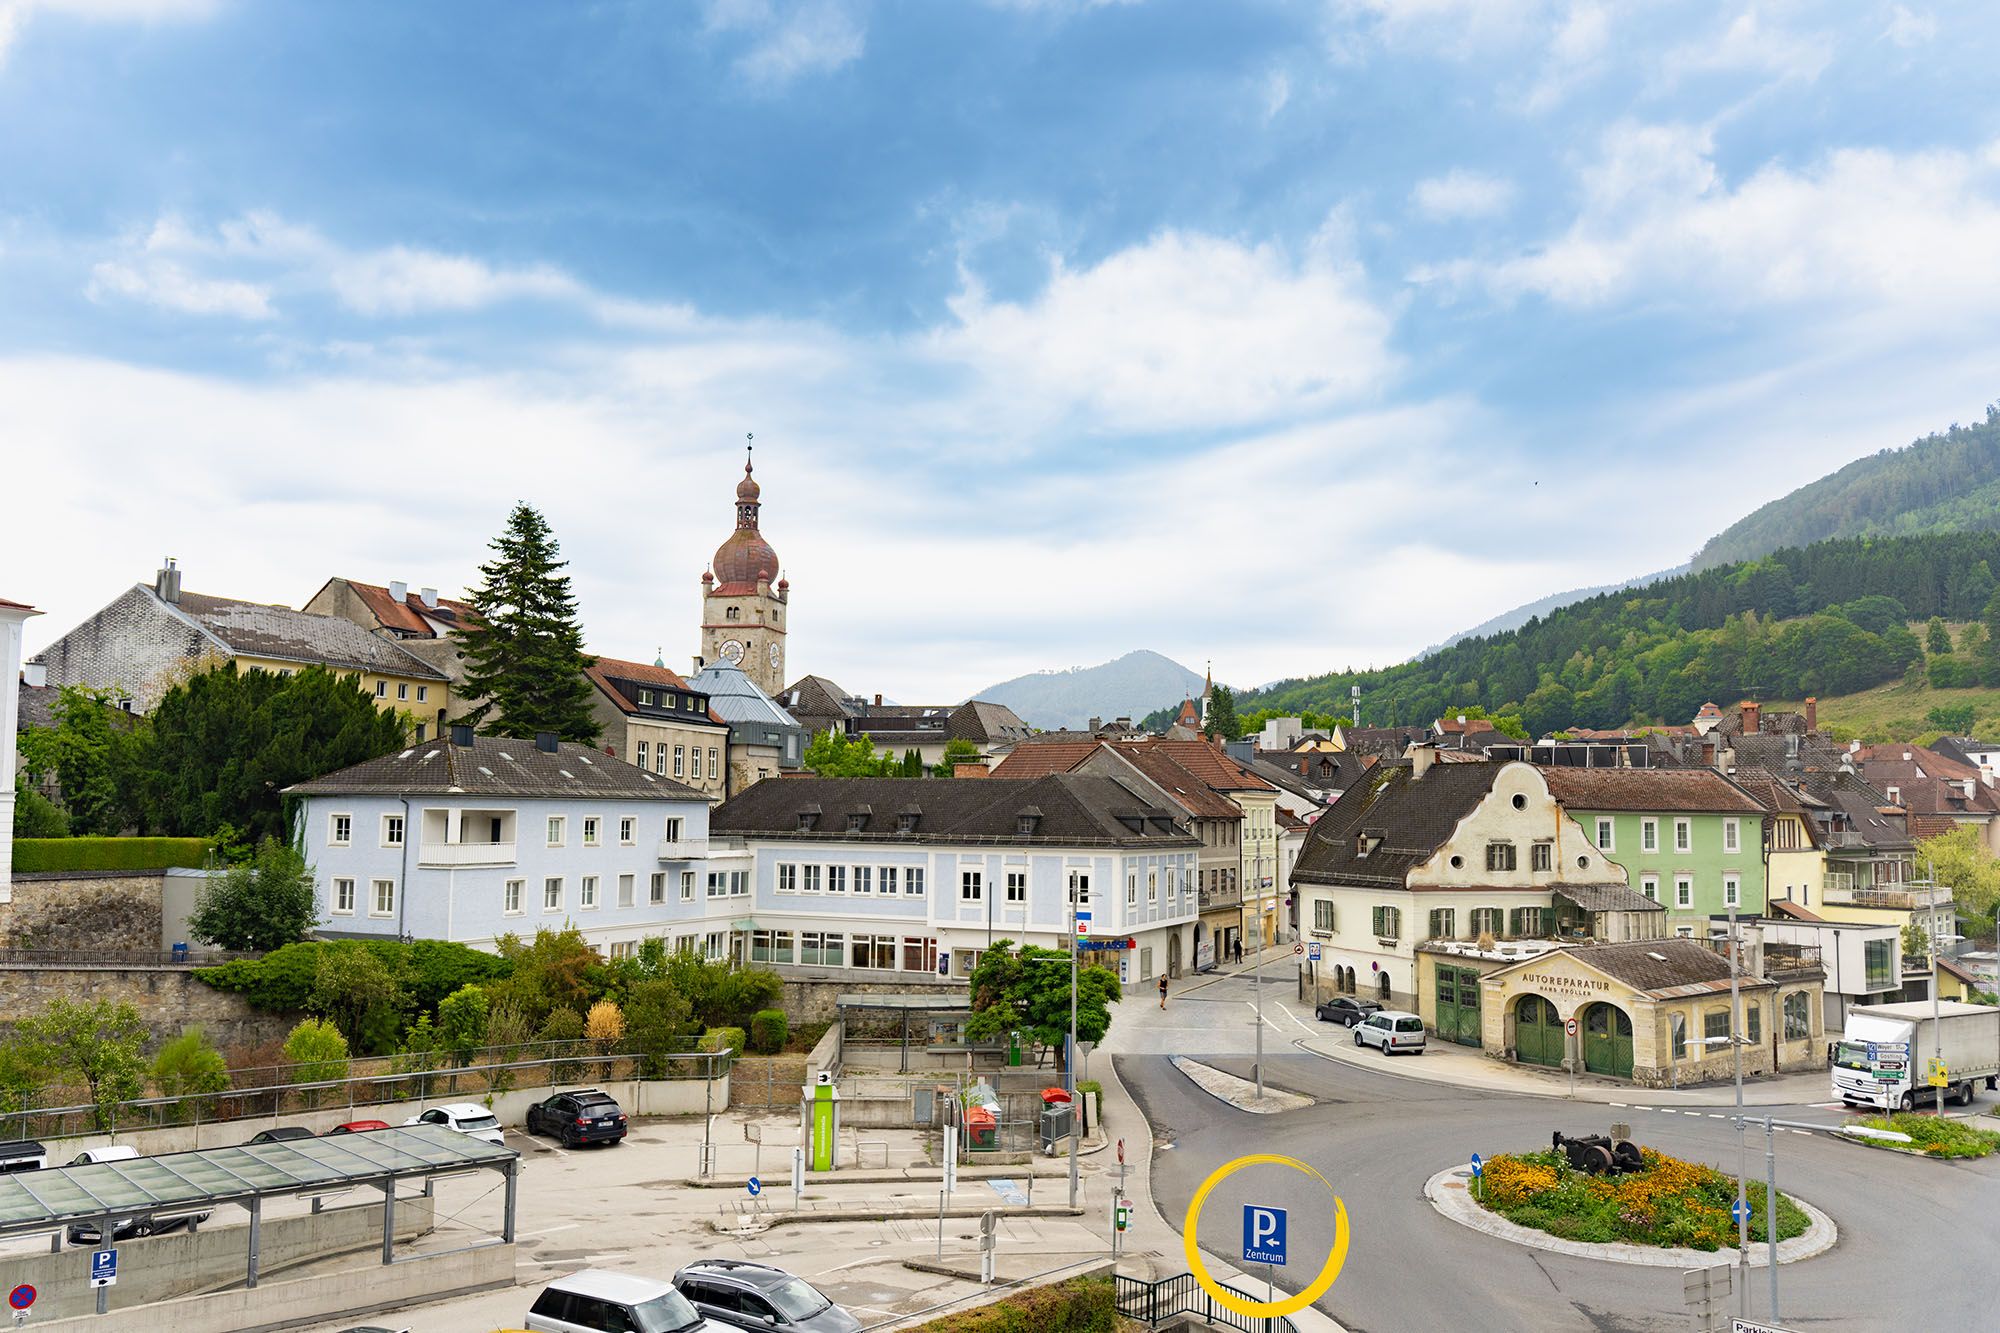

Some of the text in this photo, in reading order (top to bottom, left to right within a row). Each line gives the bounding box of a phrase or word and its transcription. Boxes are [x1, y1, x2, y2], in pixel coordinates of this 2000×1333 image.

[1522, 973, 1610, 991] AUTOREPARATUR
[1253, 1208, 1277, 1248] P
[99, 1252, 111, 1265] P
[1245, 1248, 1284, 1263] Zentrum
